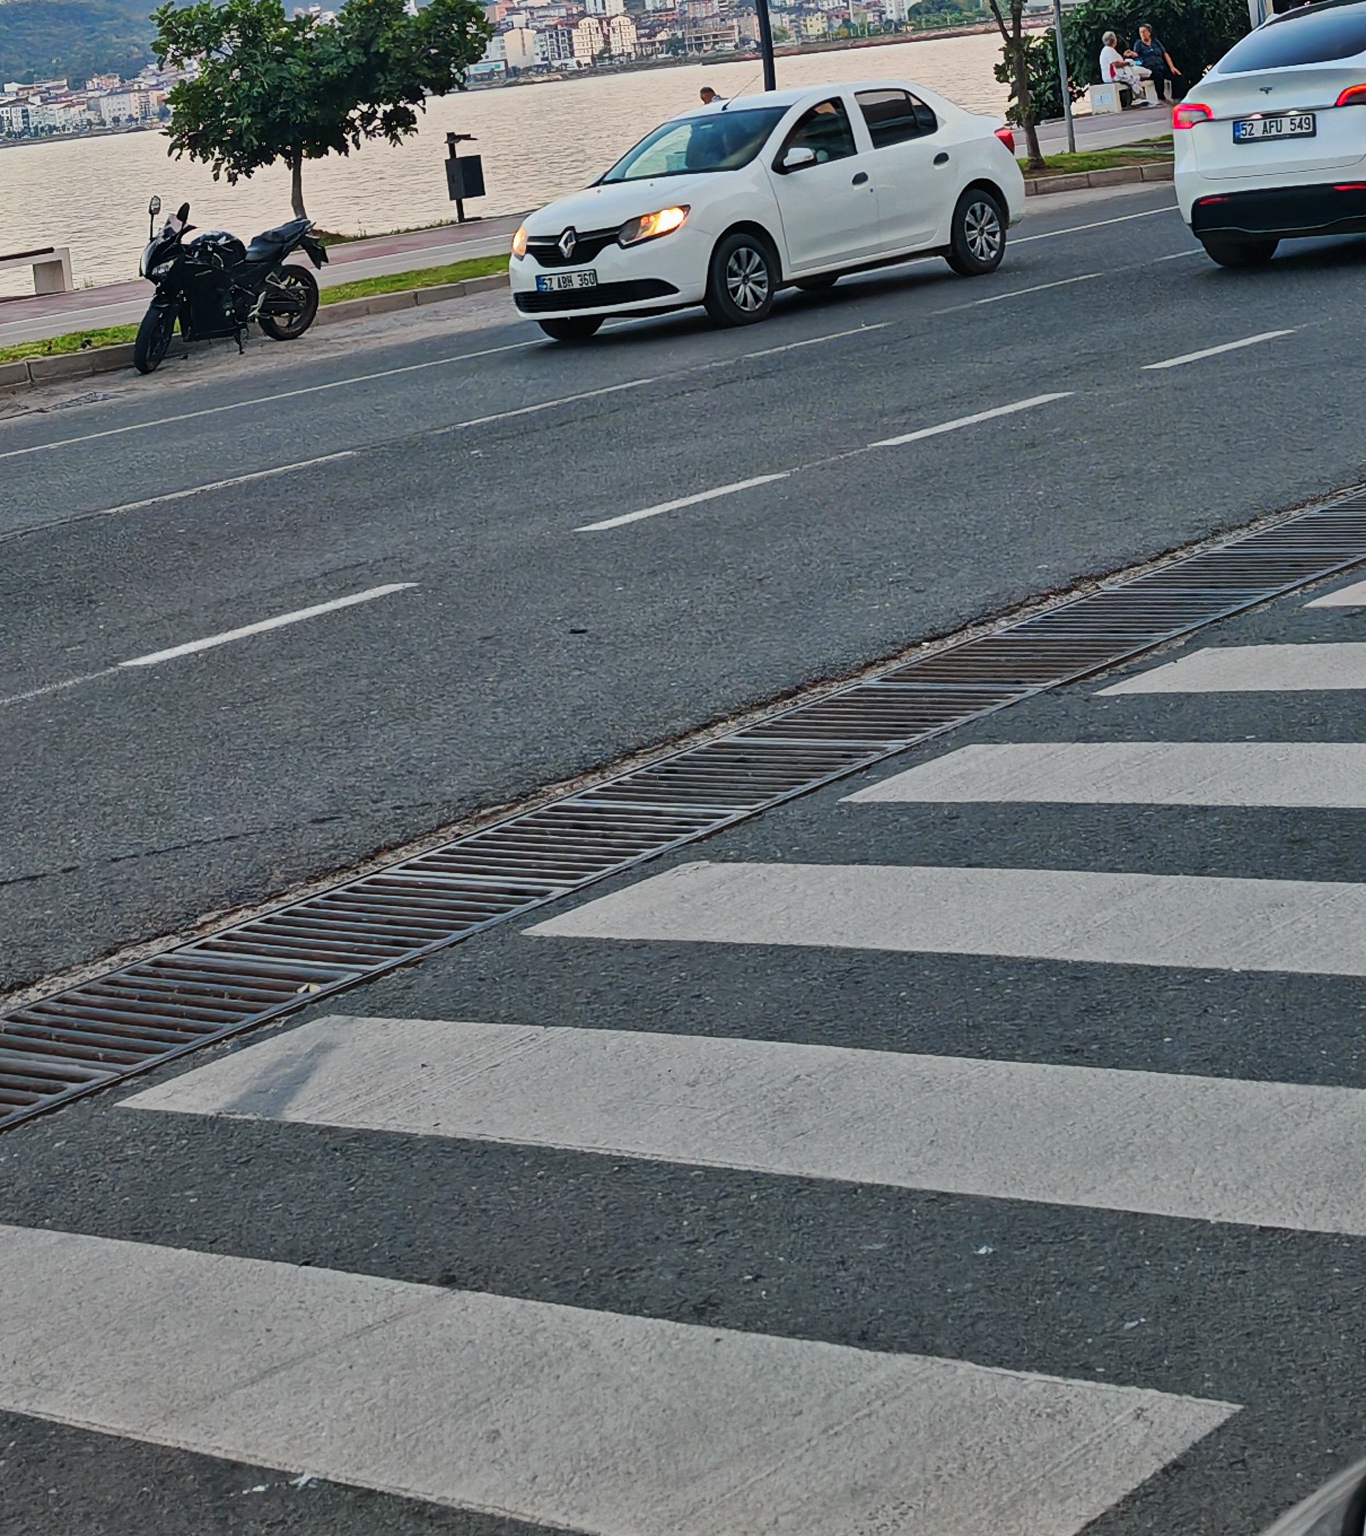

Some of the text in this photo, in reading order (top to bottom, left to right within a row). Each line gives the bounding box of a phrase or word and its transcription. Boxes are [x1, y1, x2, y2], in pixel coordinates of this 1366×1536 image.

[1240, 117, 1311, 137] 52 AFU 549
[542, 277, 553, 290] 52
[577, 272, 595, 286] 360
